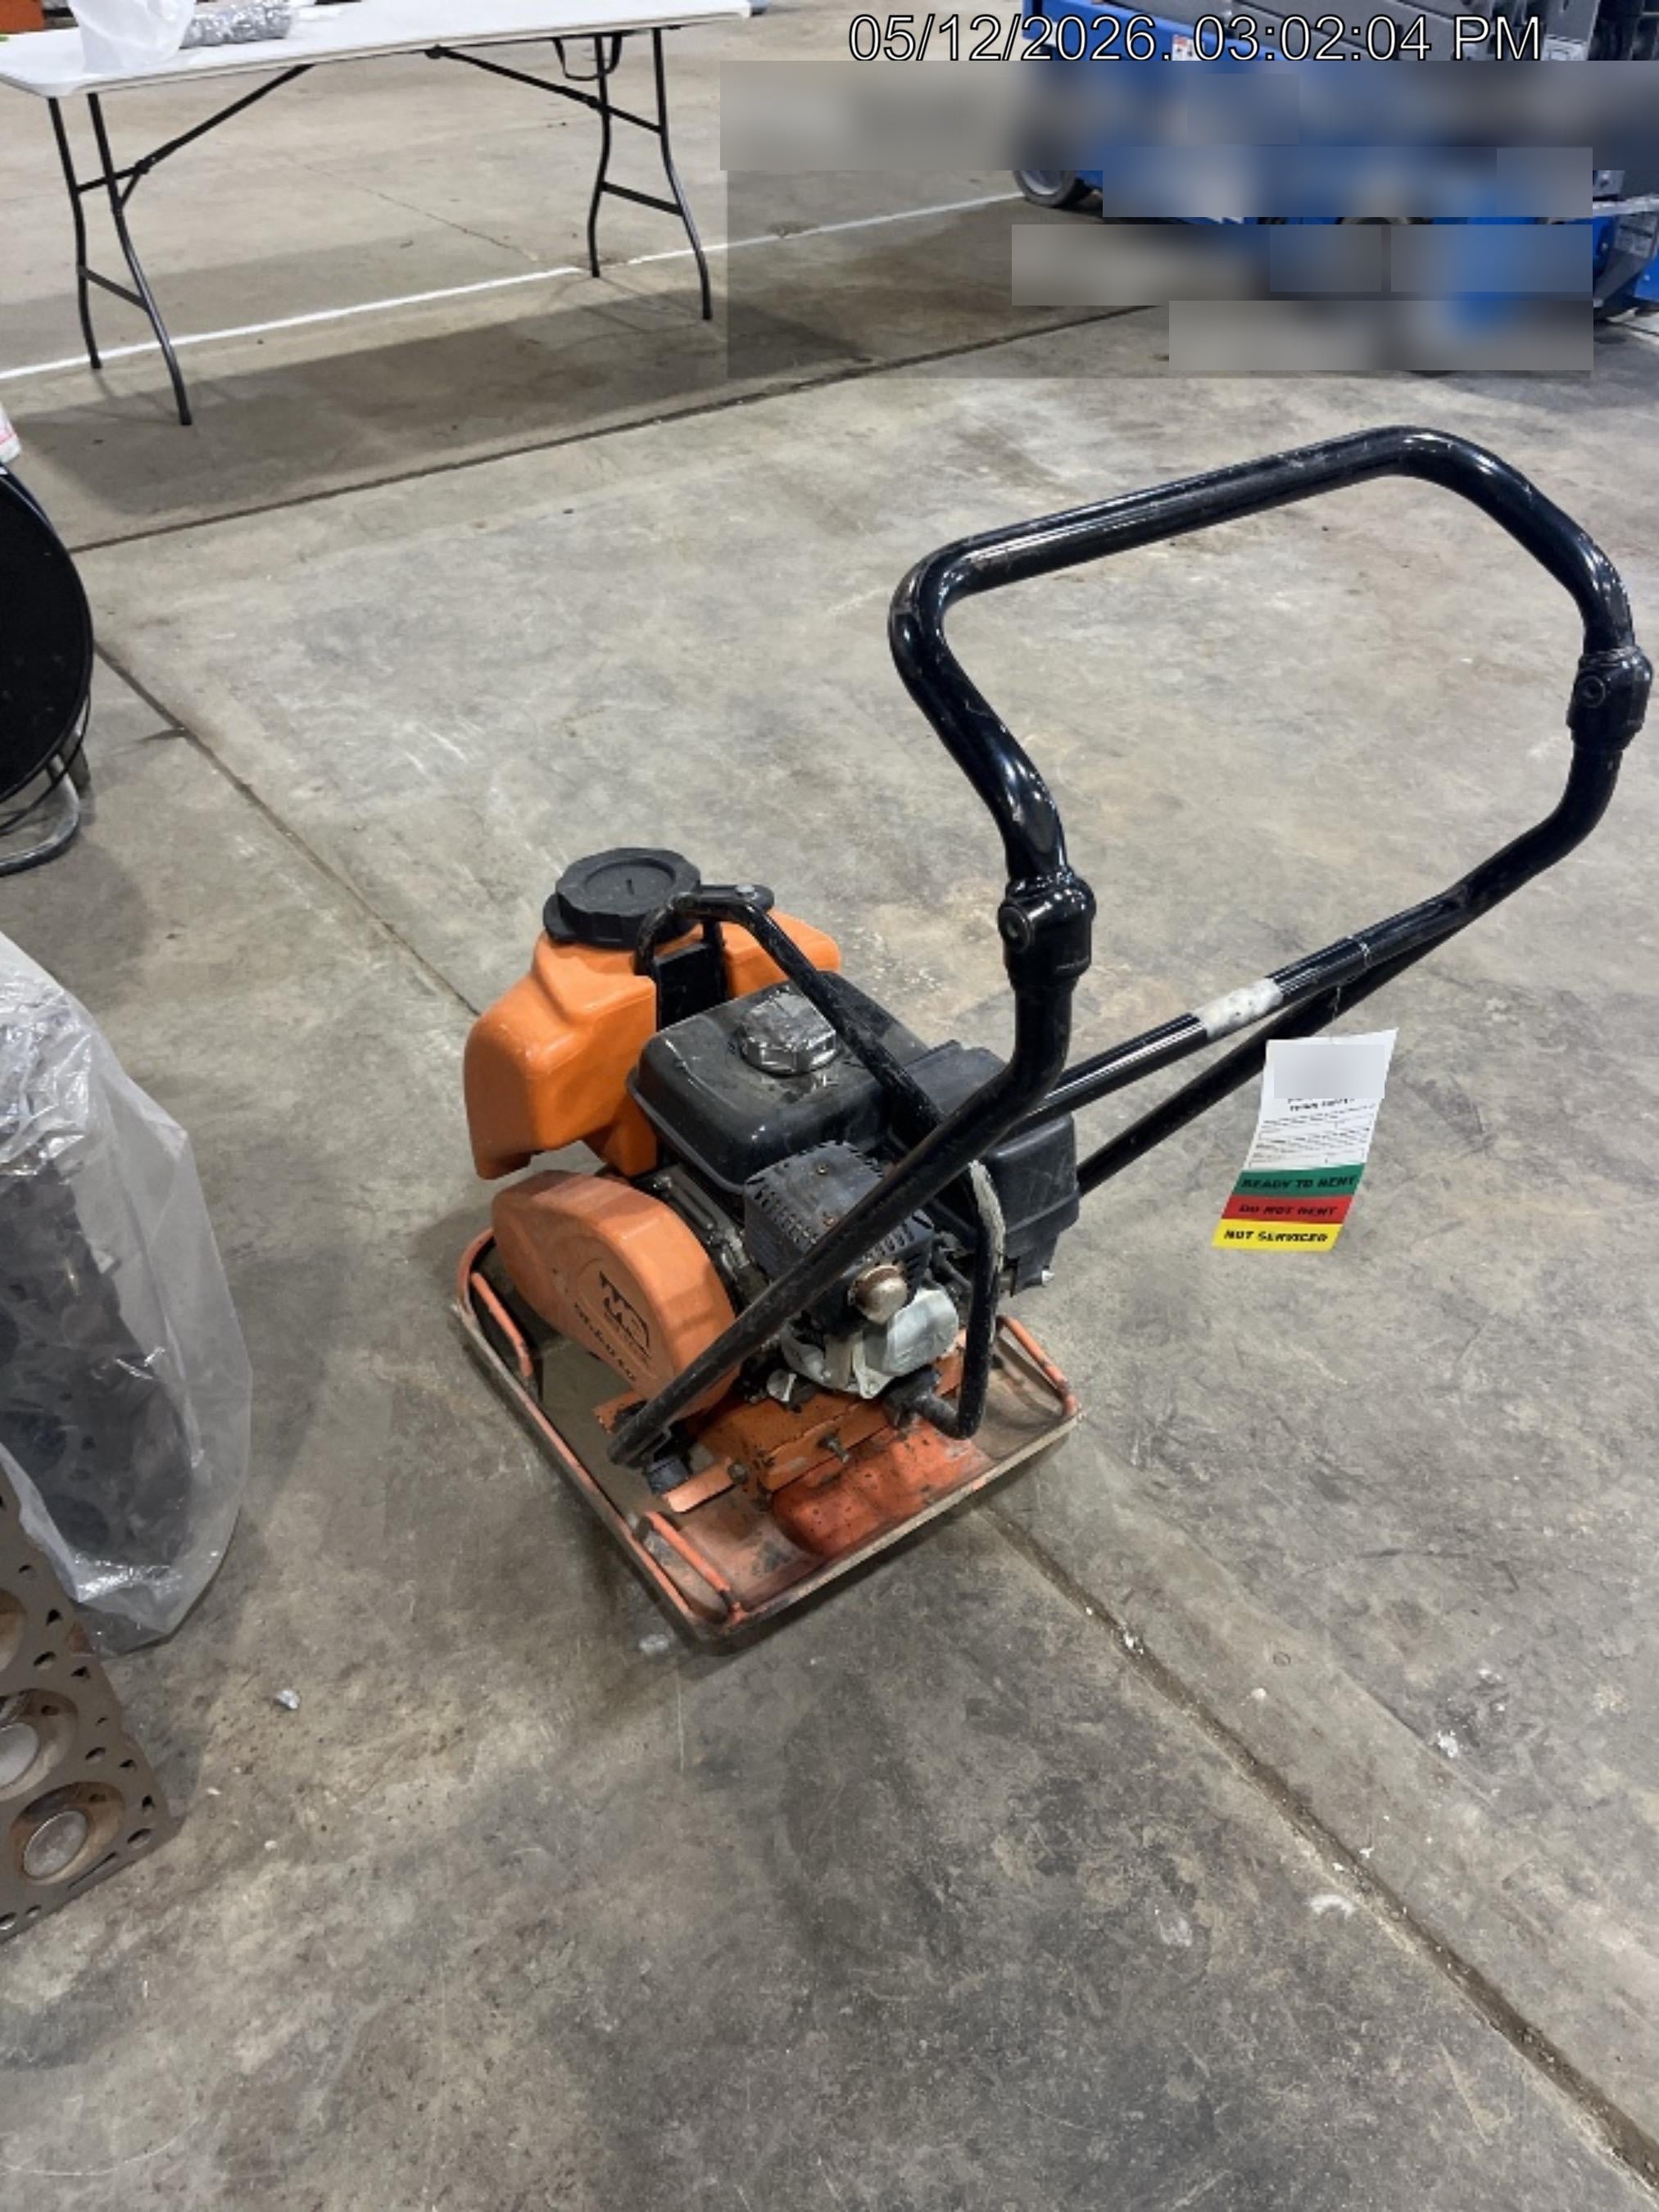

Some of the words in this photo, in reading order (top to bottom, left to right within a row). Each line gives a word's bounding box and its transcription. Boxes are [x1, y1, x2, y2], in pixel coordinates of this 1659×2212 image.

[1240, 1178, 1291, 1189] READY
[1295, 1178, 1313, 1189] TO
[1317, 1175, 1358, 1188] RENT
[1239, 1203, 1259, 1213] DO
[1263, 1204, 1294, 1214] NOT
[1297, 1206, 1338, 1216] RENT
[1223, 1230, 1255, 1240] NOT
[1258, 1231, 1328, 1242] SERVICED
